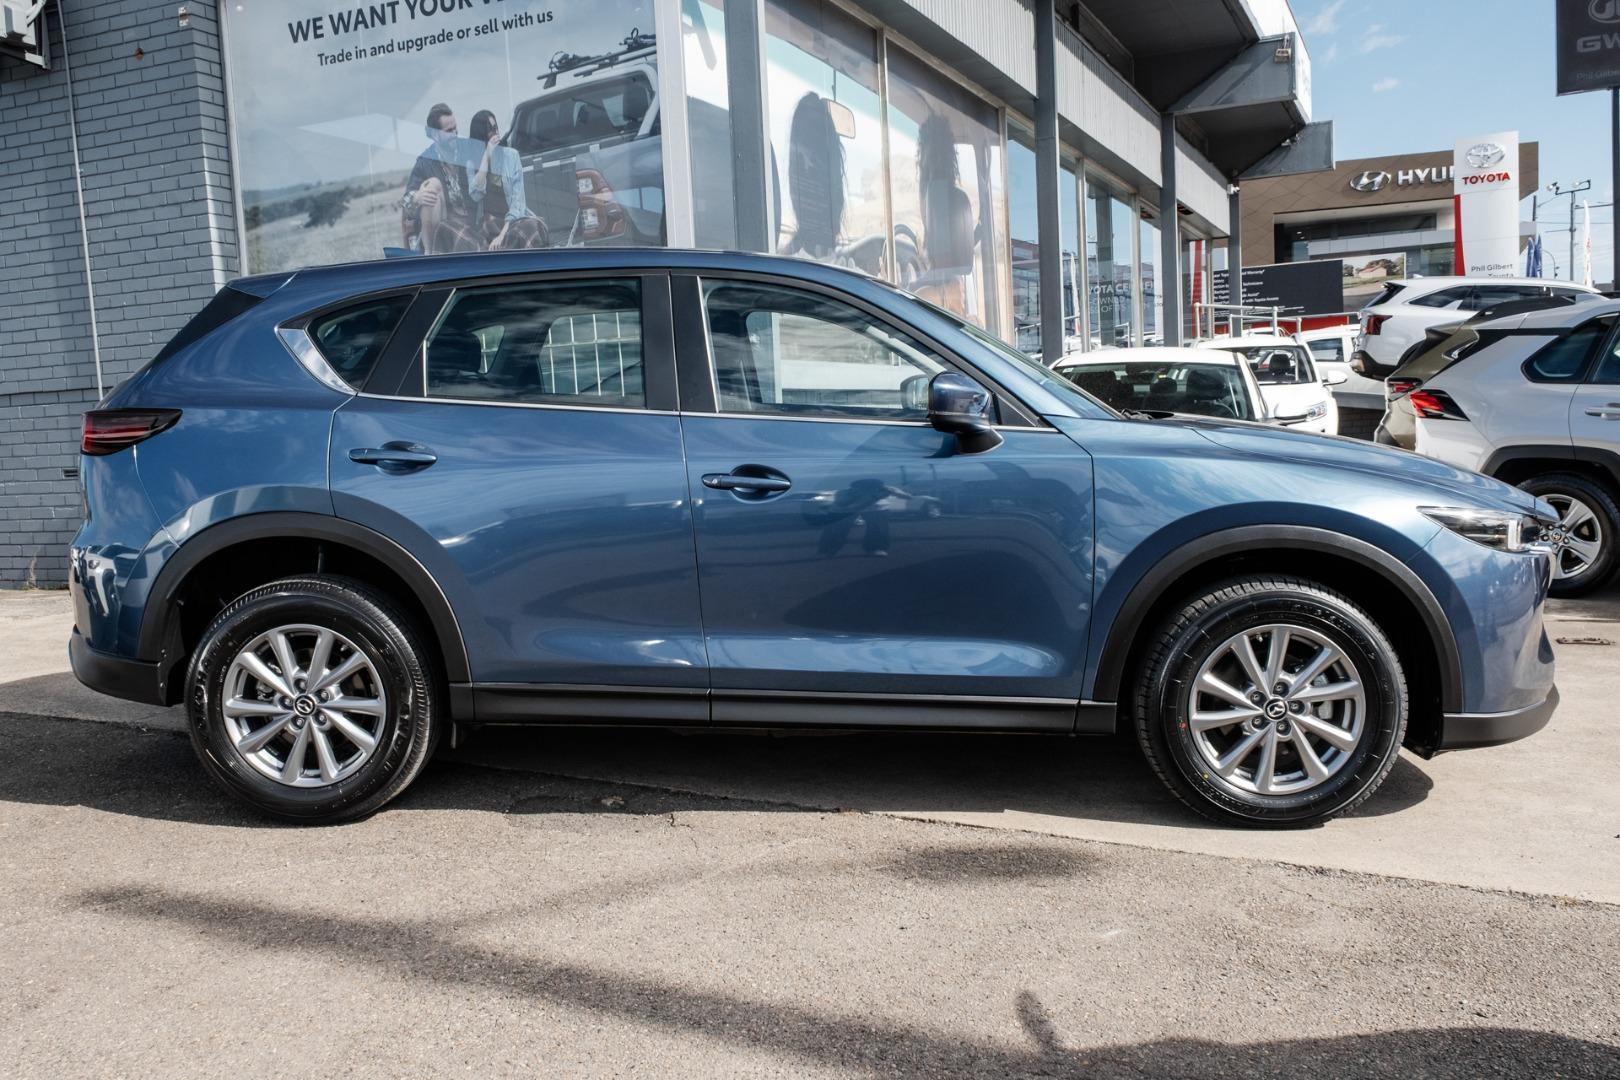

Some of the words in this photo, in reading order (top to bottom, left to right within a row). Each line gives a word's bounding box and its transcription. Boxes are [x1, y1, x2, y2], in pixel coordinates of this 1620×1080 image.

[288, 16, 325, 44] WE
[328, 1, 400, 36] WANT
[407, 0, 474, 20] YOUR
[317, 49, 353, 66] Trade
[354, 46, 368, 60] in
[370, 39, 395, 57] and
[397, 28, 454, 52] upgrade
[456, 25, 472, 40] or
[474, 18, 500, 36] sell
[501, 13, 534, 31] with
[536, 10, 554, 24] us
[1462, 172, 1510, 185] TOYOTA
[1471, 264, 1486, 272] Phil
[1487, 263, 1513, 271] Gilbert
